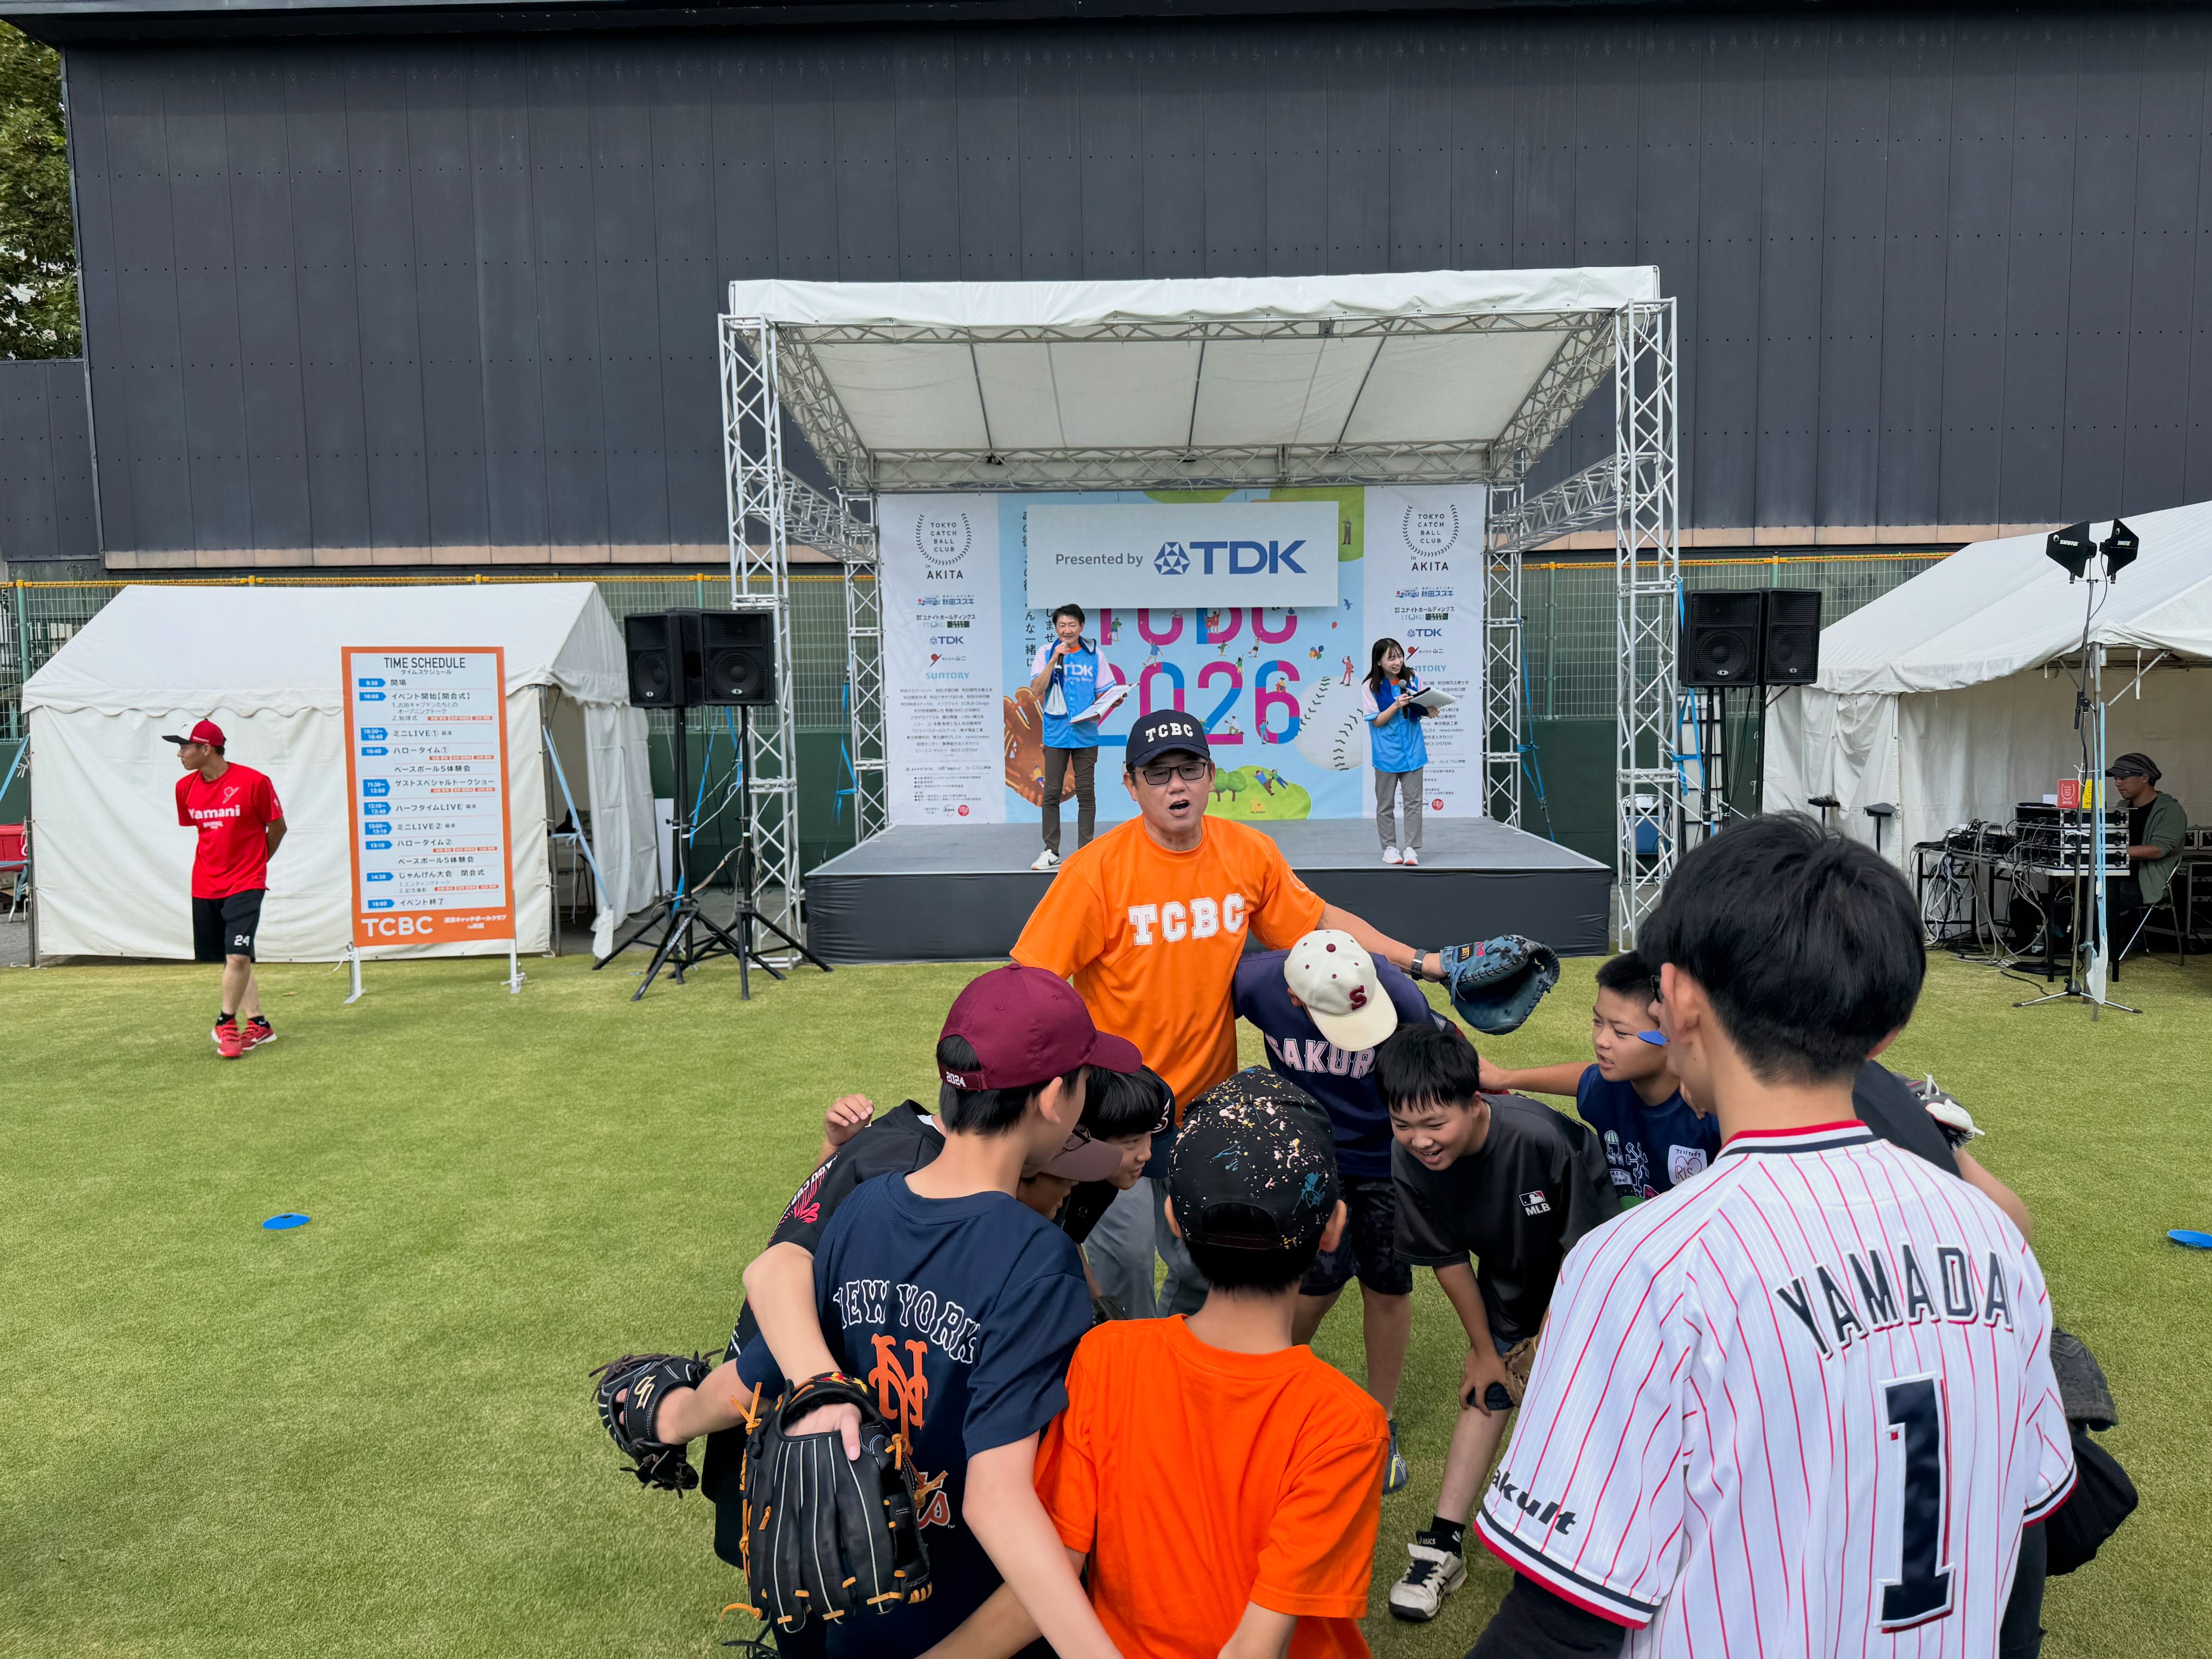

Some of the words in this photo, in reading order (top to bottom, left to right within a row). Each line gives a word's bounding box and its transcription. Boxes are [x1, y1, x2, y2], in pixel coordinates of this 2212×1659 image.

[1056, 553, 1124, 565] Presented
[1127, 552, 1143, 568] by
[1189, 540, 1307, 575] TDK
[1412, 562, 1448, 571] AKITA
[927, 570, 963, 579] AKITA
[938, 636, 963, 644] TDK
[384, 658, 408, 668] TIME
[412, 658, 466, 668] SCHEDULE
[1063, 664, 1093, 677] TDK
[1145, 723, 1193, 743] TCBC
[188, 804, 240, 819] Yamani
[361, 916, 433, 937] TCBC
[1128, 893, 1244, 946] TCBC
[234, 935, 250, 947] 24
[1349, 985, 1367, 1010] S
[1265, 1033, 1375, 1079] SAKUR
[946, 1071, 966, 1087] 2024
[1525, 1202, 1551, 1216] MLB
[1773, 1240, 2013, 1360] YAMADA
[896, 1283, 981, 1364] YORK
[1492, 1468, 1576, 1535] akult
[1873, 1370, 1956, 1634] 1
